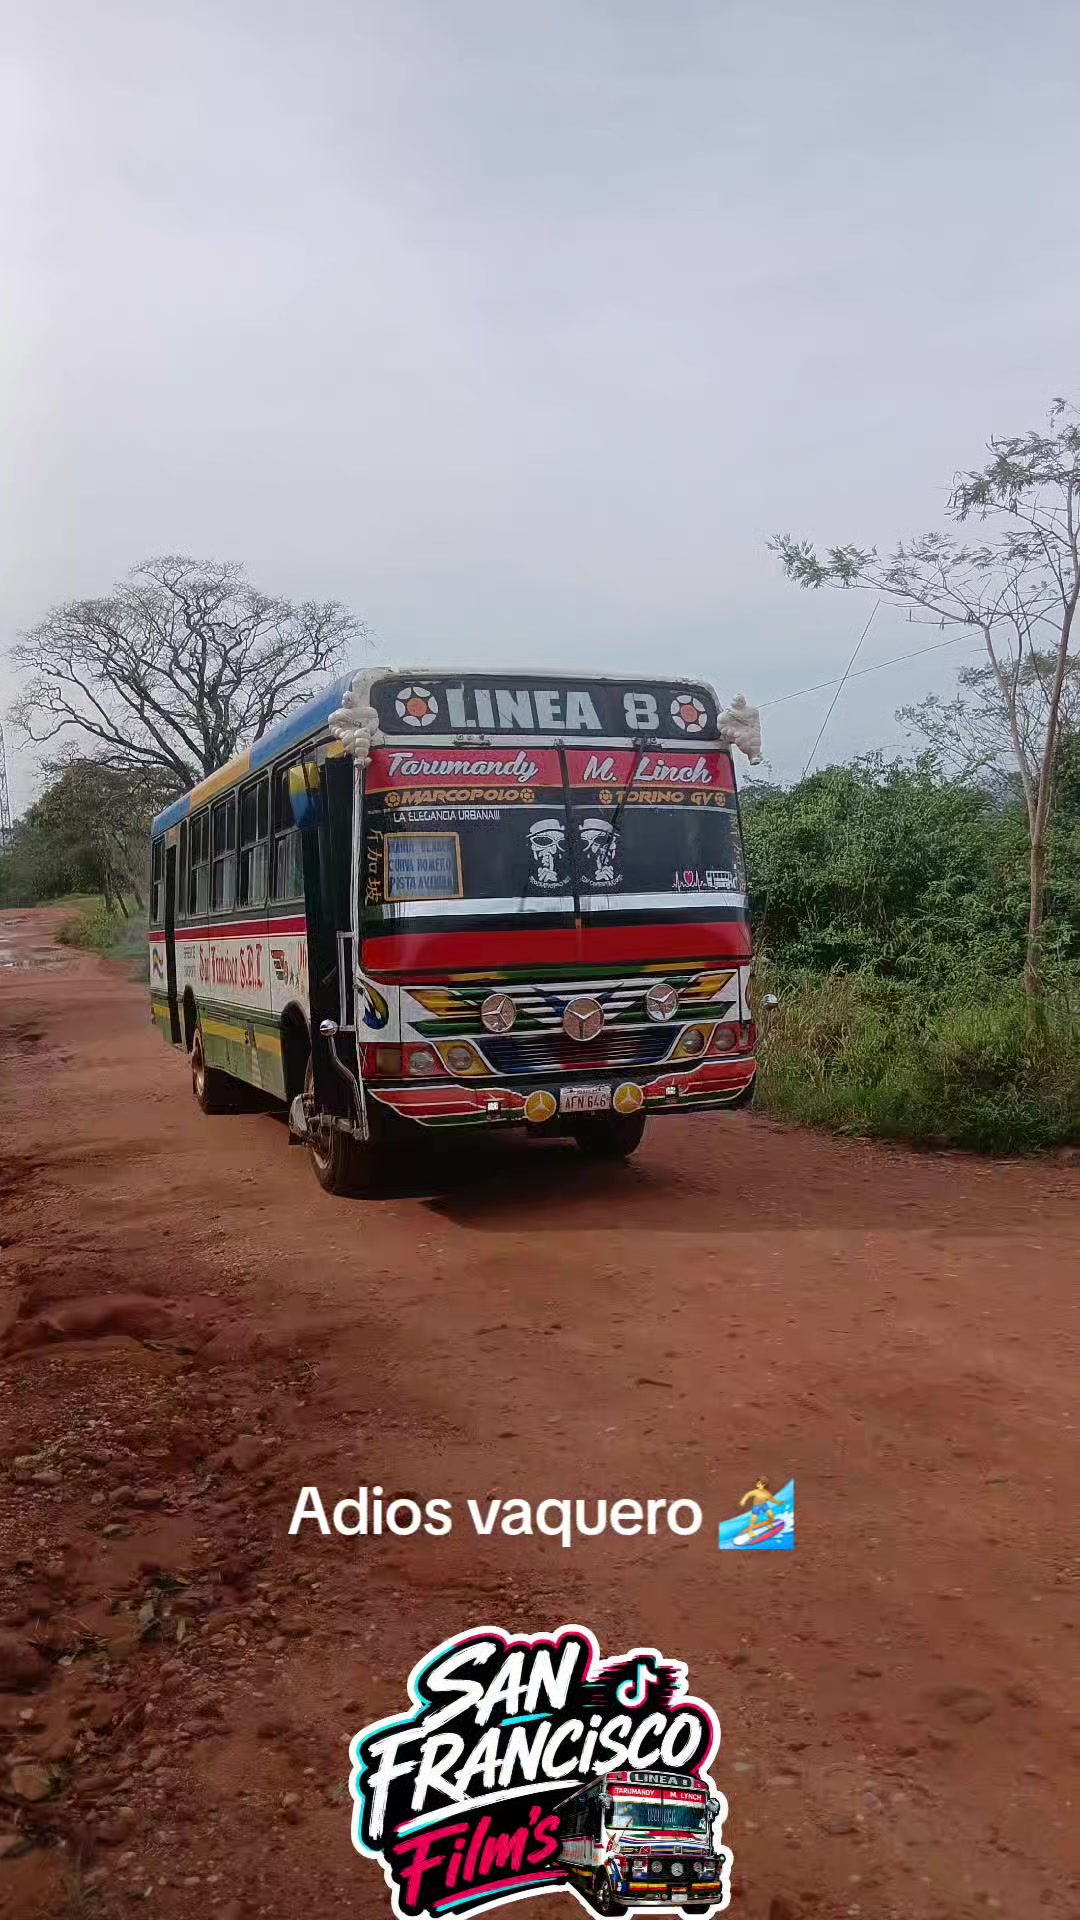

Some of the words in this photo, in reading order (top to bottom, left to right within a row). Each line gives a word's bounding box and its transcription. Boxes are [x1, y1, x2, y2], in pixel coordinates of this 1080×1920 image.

[446, 688, 603, 730] LINEA
[624, 692, 660, 730] 8
[388, 750, 538, 783] Tarumandy
[583, 755, 617, 781] M.
[633, 756, 712, 783] Linch
[401, 788, 520, 805] MARCOPOLO
[616, 790, 685, 804] TORINO
[393, 811, 406, 823] LA
[408, 810, 457, 822] ELEGANCIA
[565, 1095, 585, 1109] AFN
[587, 1093, 607, 1108] 646
